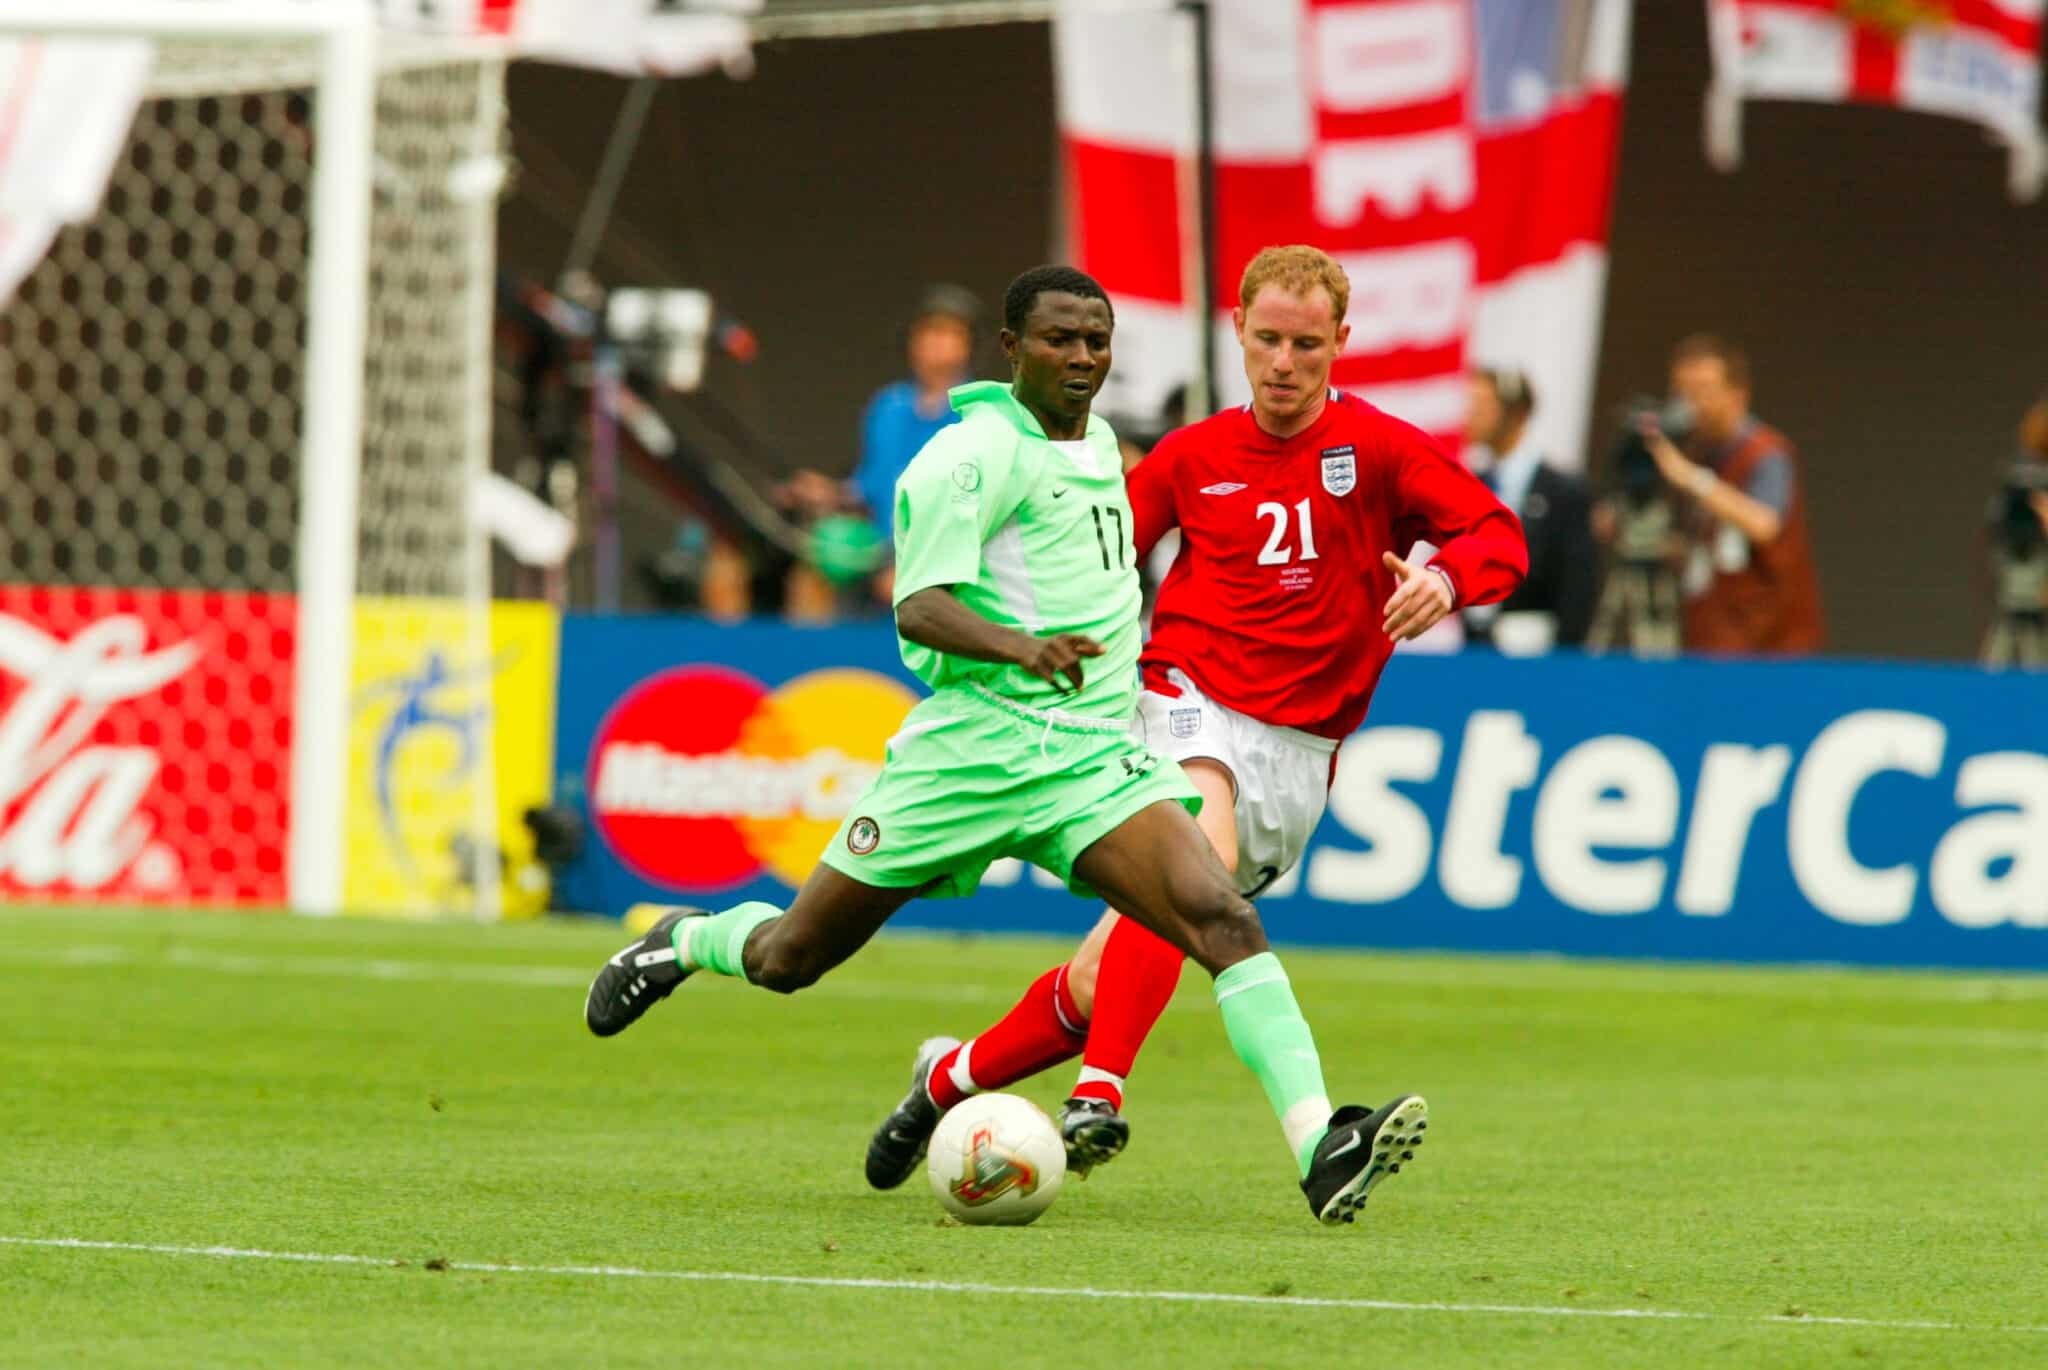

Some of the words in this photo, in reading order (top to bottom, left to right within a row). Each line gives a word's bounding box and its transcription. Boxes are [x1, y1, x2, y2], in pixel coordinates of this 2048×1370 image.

[1091, 504, 1126, 570] 17
[1256, 497, 1319, 565] 21
[600, 741, 884, 820] MasterC
[980, 708, 2048, 928] sterCa
